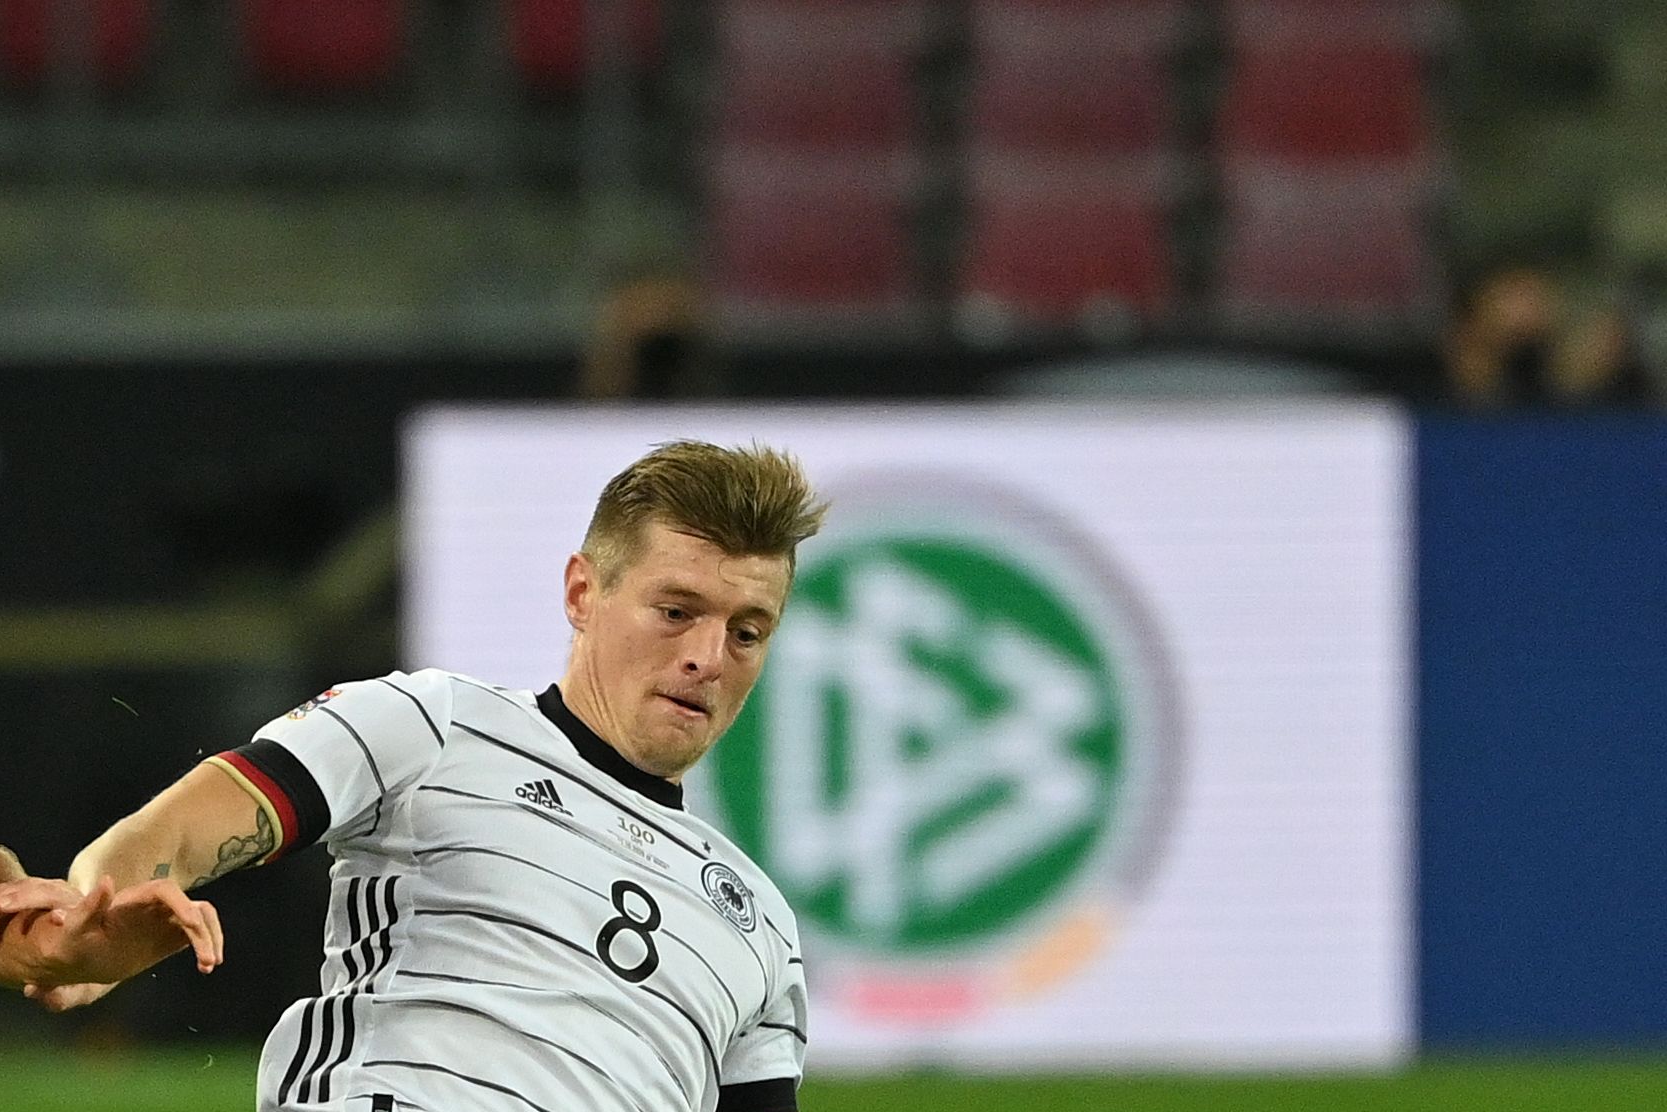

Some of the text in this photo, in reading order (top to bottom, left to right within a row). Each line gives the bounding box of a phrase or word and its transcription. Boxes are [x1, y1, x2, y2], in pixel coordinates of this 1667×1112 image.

[515, 786, 574, 817] adidas
[617, 816, 655, 845] 100
[596, 880, 661, 983] 8
